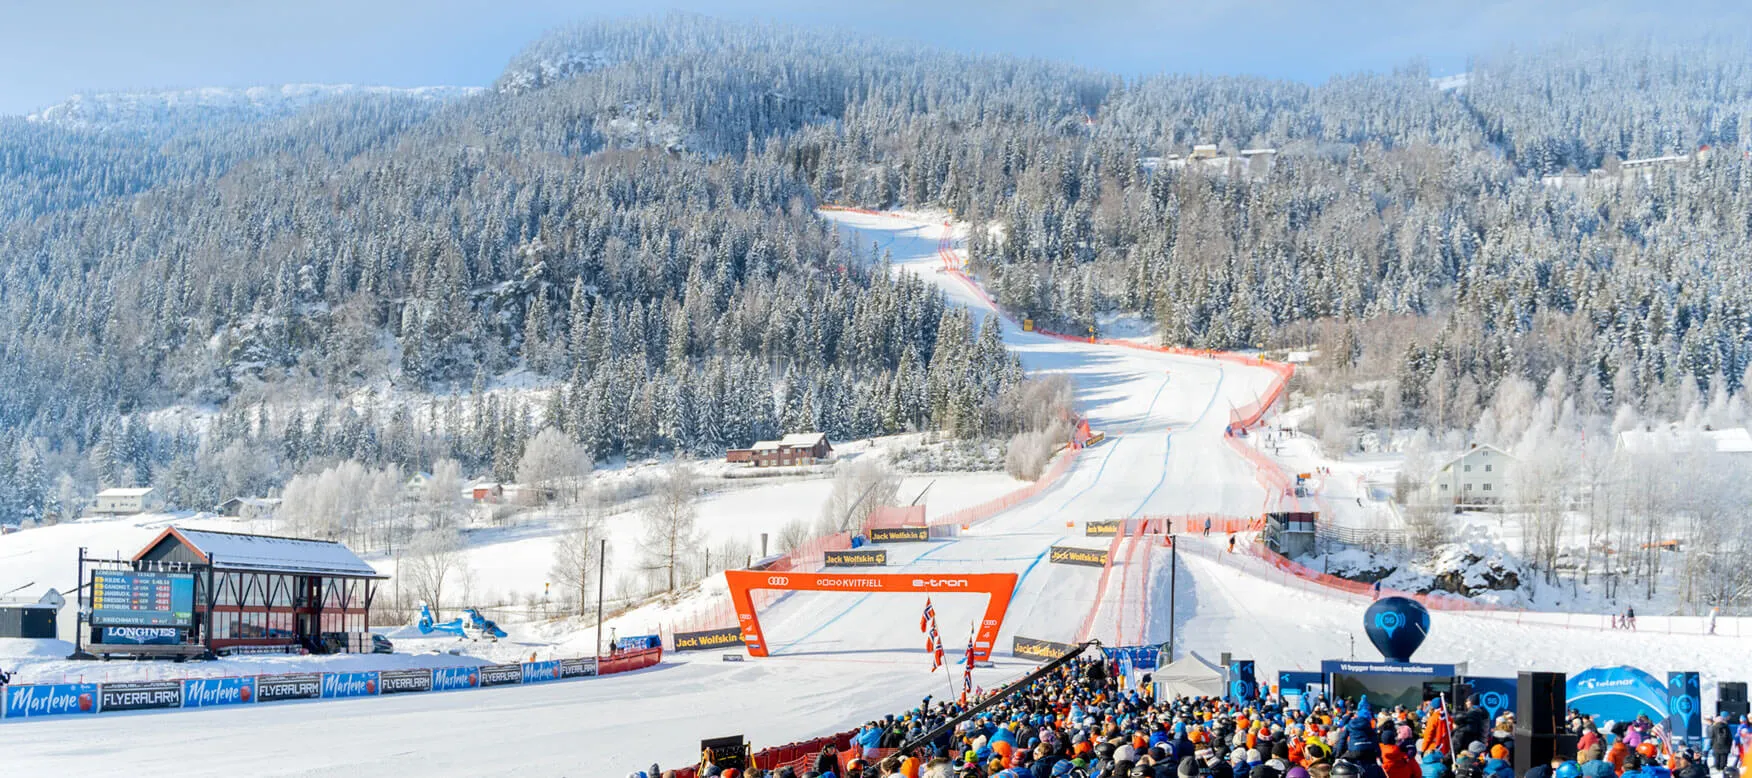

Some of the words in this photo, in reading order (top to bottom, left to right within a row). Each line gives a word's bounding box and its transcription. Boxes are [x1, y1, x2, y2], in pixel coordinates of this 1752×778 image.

[872, 532, 888, 540] Jack
[890, 531, 918, 539] Wolfskin
[827, 556, 842, 564] Jack
[843, 554, 874, 563] Wolfskin
[1052, 551, 1068, 560] Jack
[1070, 553, 1098, 562] Wolfskin
[843, 579, 882, 588] KVITFJELL
[912, 579, 968, 588] e-tron
[108, 627, 176, 637] LONGINES
[676, 638, 698, 648] Jack
[699, 634, 737, 646] Wolfskin
[382, 678, 430, 689] FLYERALARM
[436, 668, 468, 691] Marlene
[260, 682, 318, 697] FLYERALARM
[326, 674, 365, 698] Marlene
[103, 691, 179, 706] FLYERALARM
[188, 680, 239, 707] Marlene
[11, 686, 77, 718] Marlene
